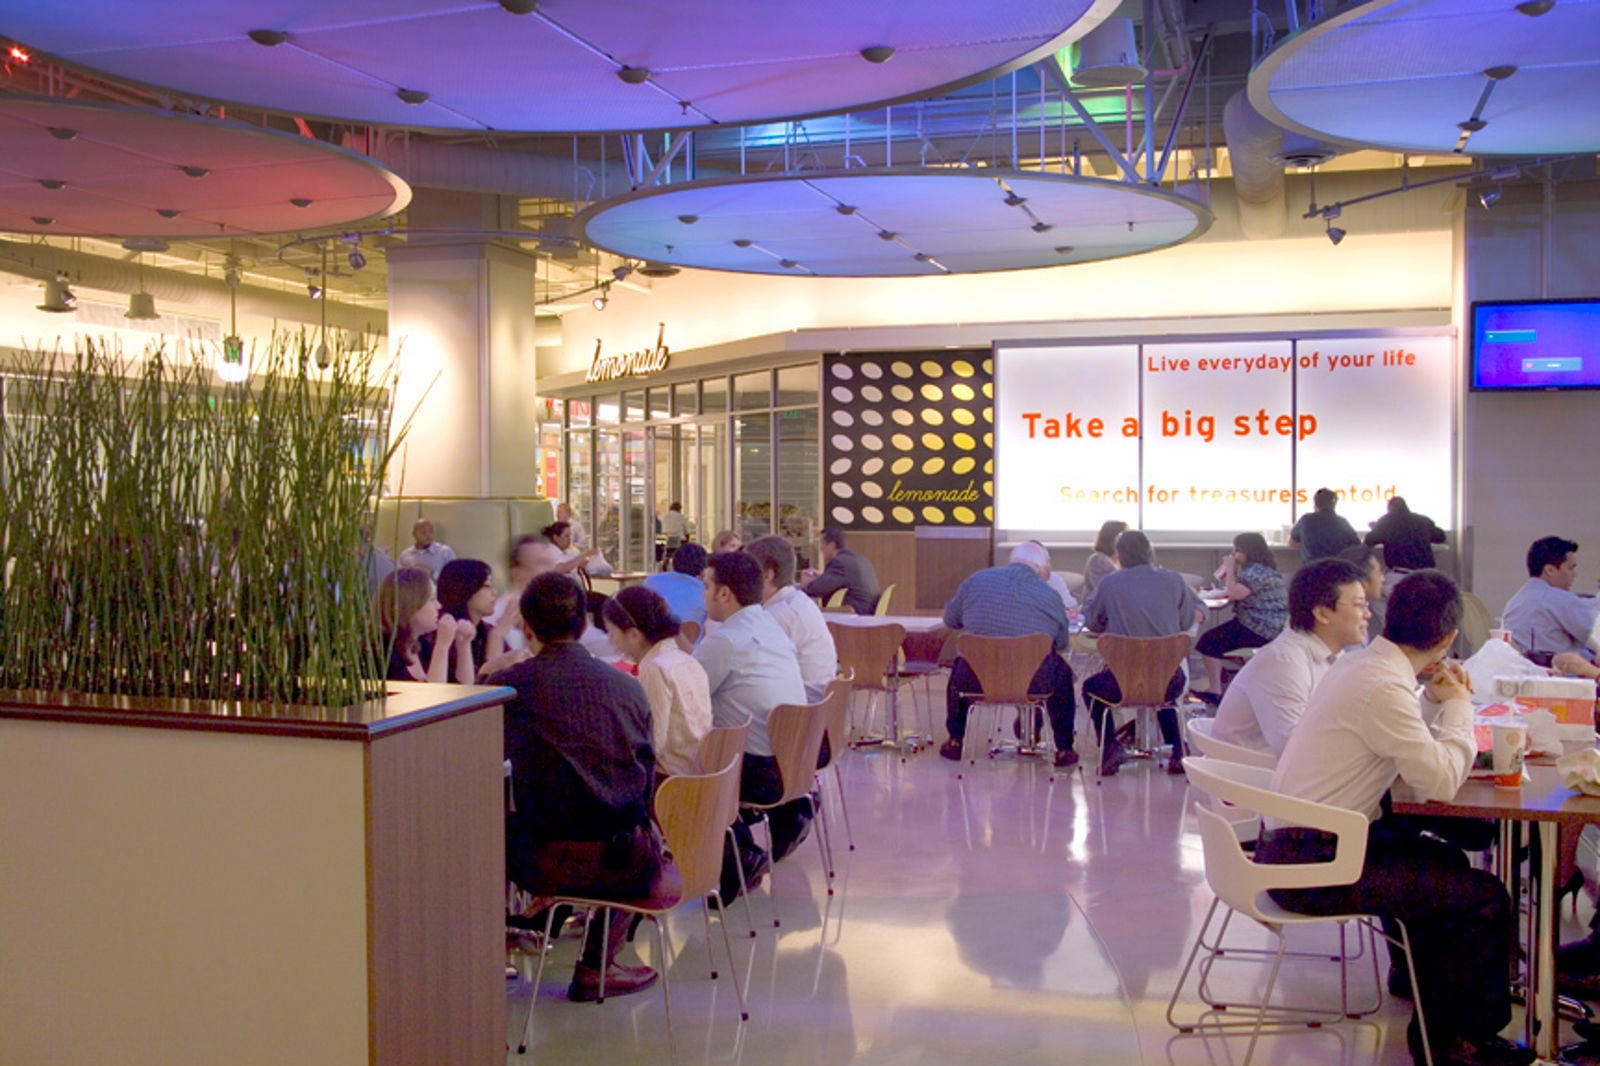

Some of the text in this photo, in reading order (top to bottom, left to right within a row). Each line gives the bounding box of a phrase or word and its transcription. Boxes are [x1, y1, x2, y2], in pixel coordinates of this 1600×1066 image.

[585, 322, 670, 383] lemonade
[1148, 350, 1416, 373] Live everyday of your life
[1022, 408, 1318, 442] Take a big step
[887, 479, 979, 502] lemonade
[1059, 484, 1397, 504] Search for treasures ntold
